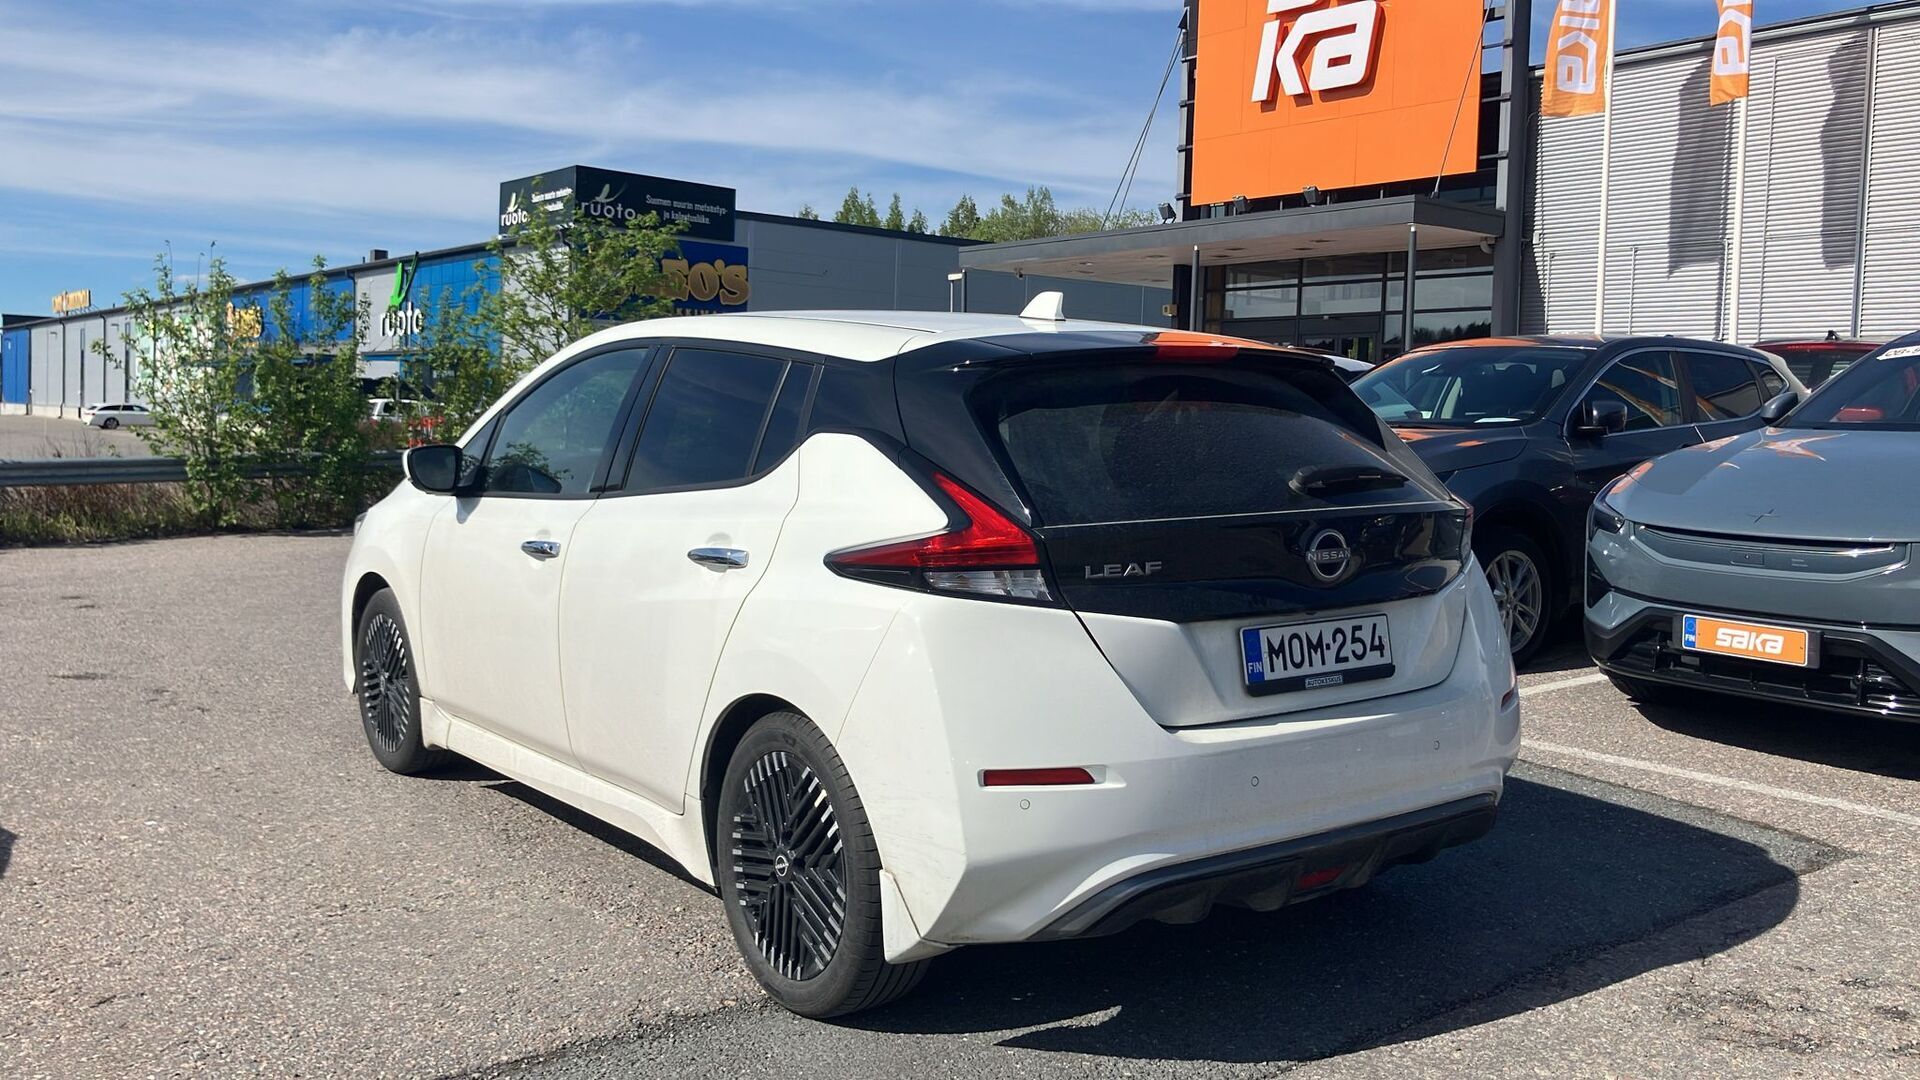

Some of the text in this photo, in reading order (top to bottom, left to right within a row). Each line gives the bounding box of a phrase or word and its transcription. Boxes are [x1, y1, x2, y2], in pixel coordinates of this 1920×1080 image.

[1307, 548, 1350, 561] NISSAN
[1085, 561, 1162, 579] LEAF
[1685, 634, 1696, 642] FIN
[1715, 627, 1784, 655] saka
[1266, 623, 1386, 673] MOM-254
[1248, 662, 1263, 674] FIN
